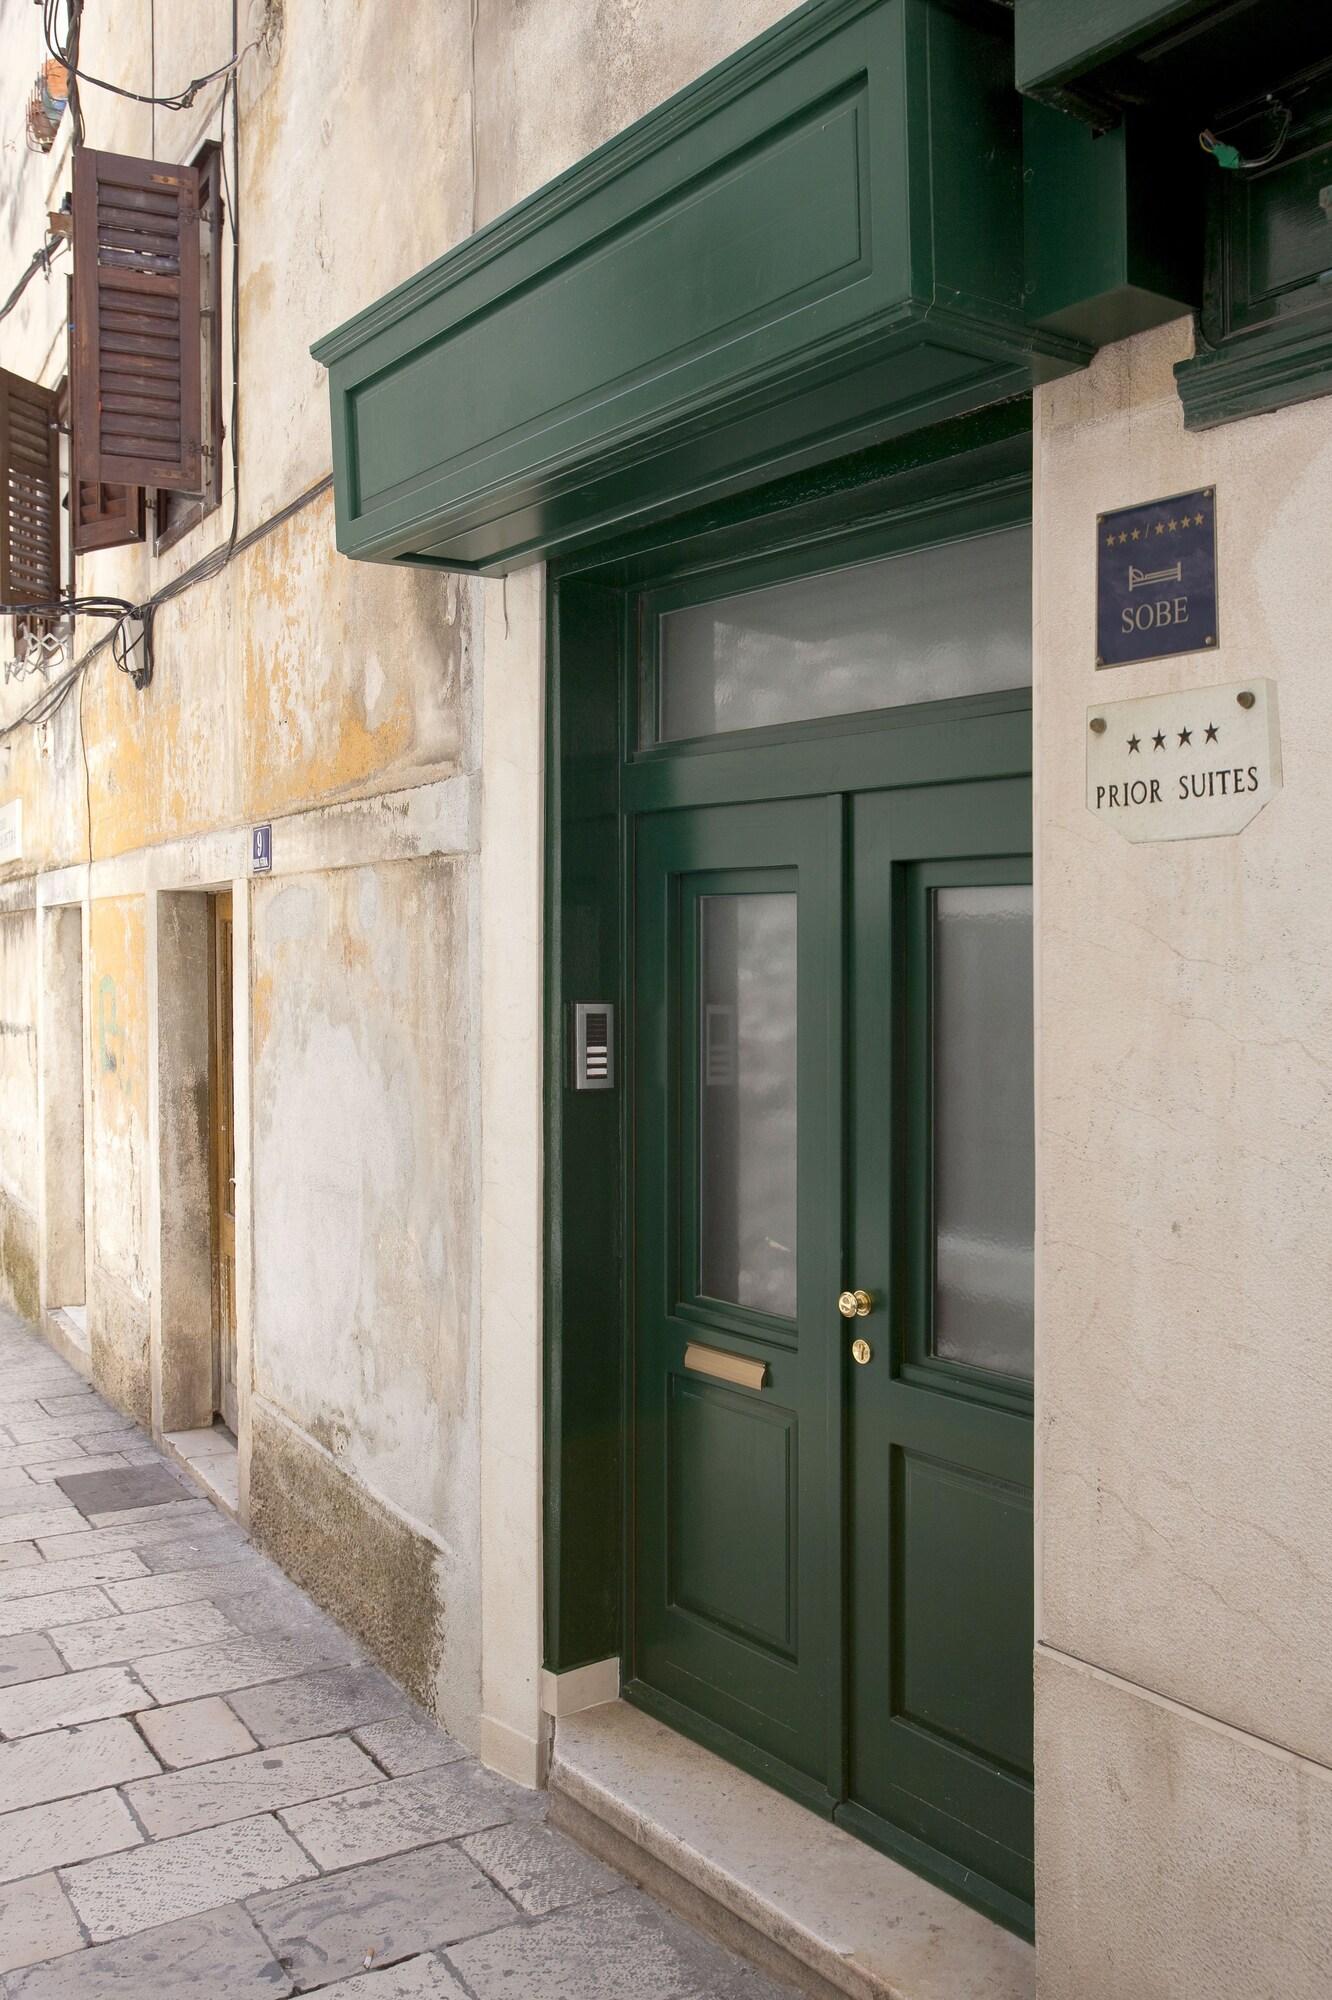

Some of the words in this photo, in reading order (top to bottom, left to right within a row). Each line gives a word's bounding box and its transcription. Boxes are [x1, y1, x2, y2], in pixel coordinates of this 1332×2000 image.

[1121, 597, 1188, 633] SOBE
[1096, 779, 1163, 808] PRIOR
[1179, 766, 1259, 799] SUITES
[256, 831, 262, 857] 9
